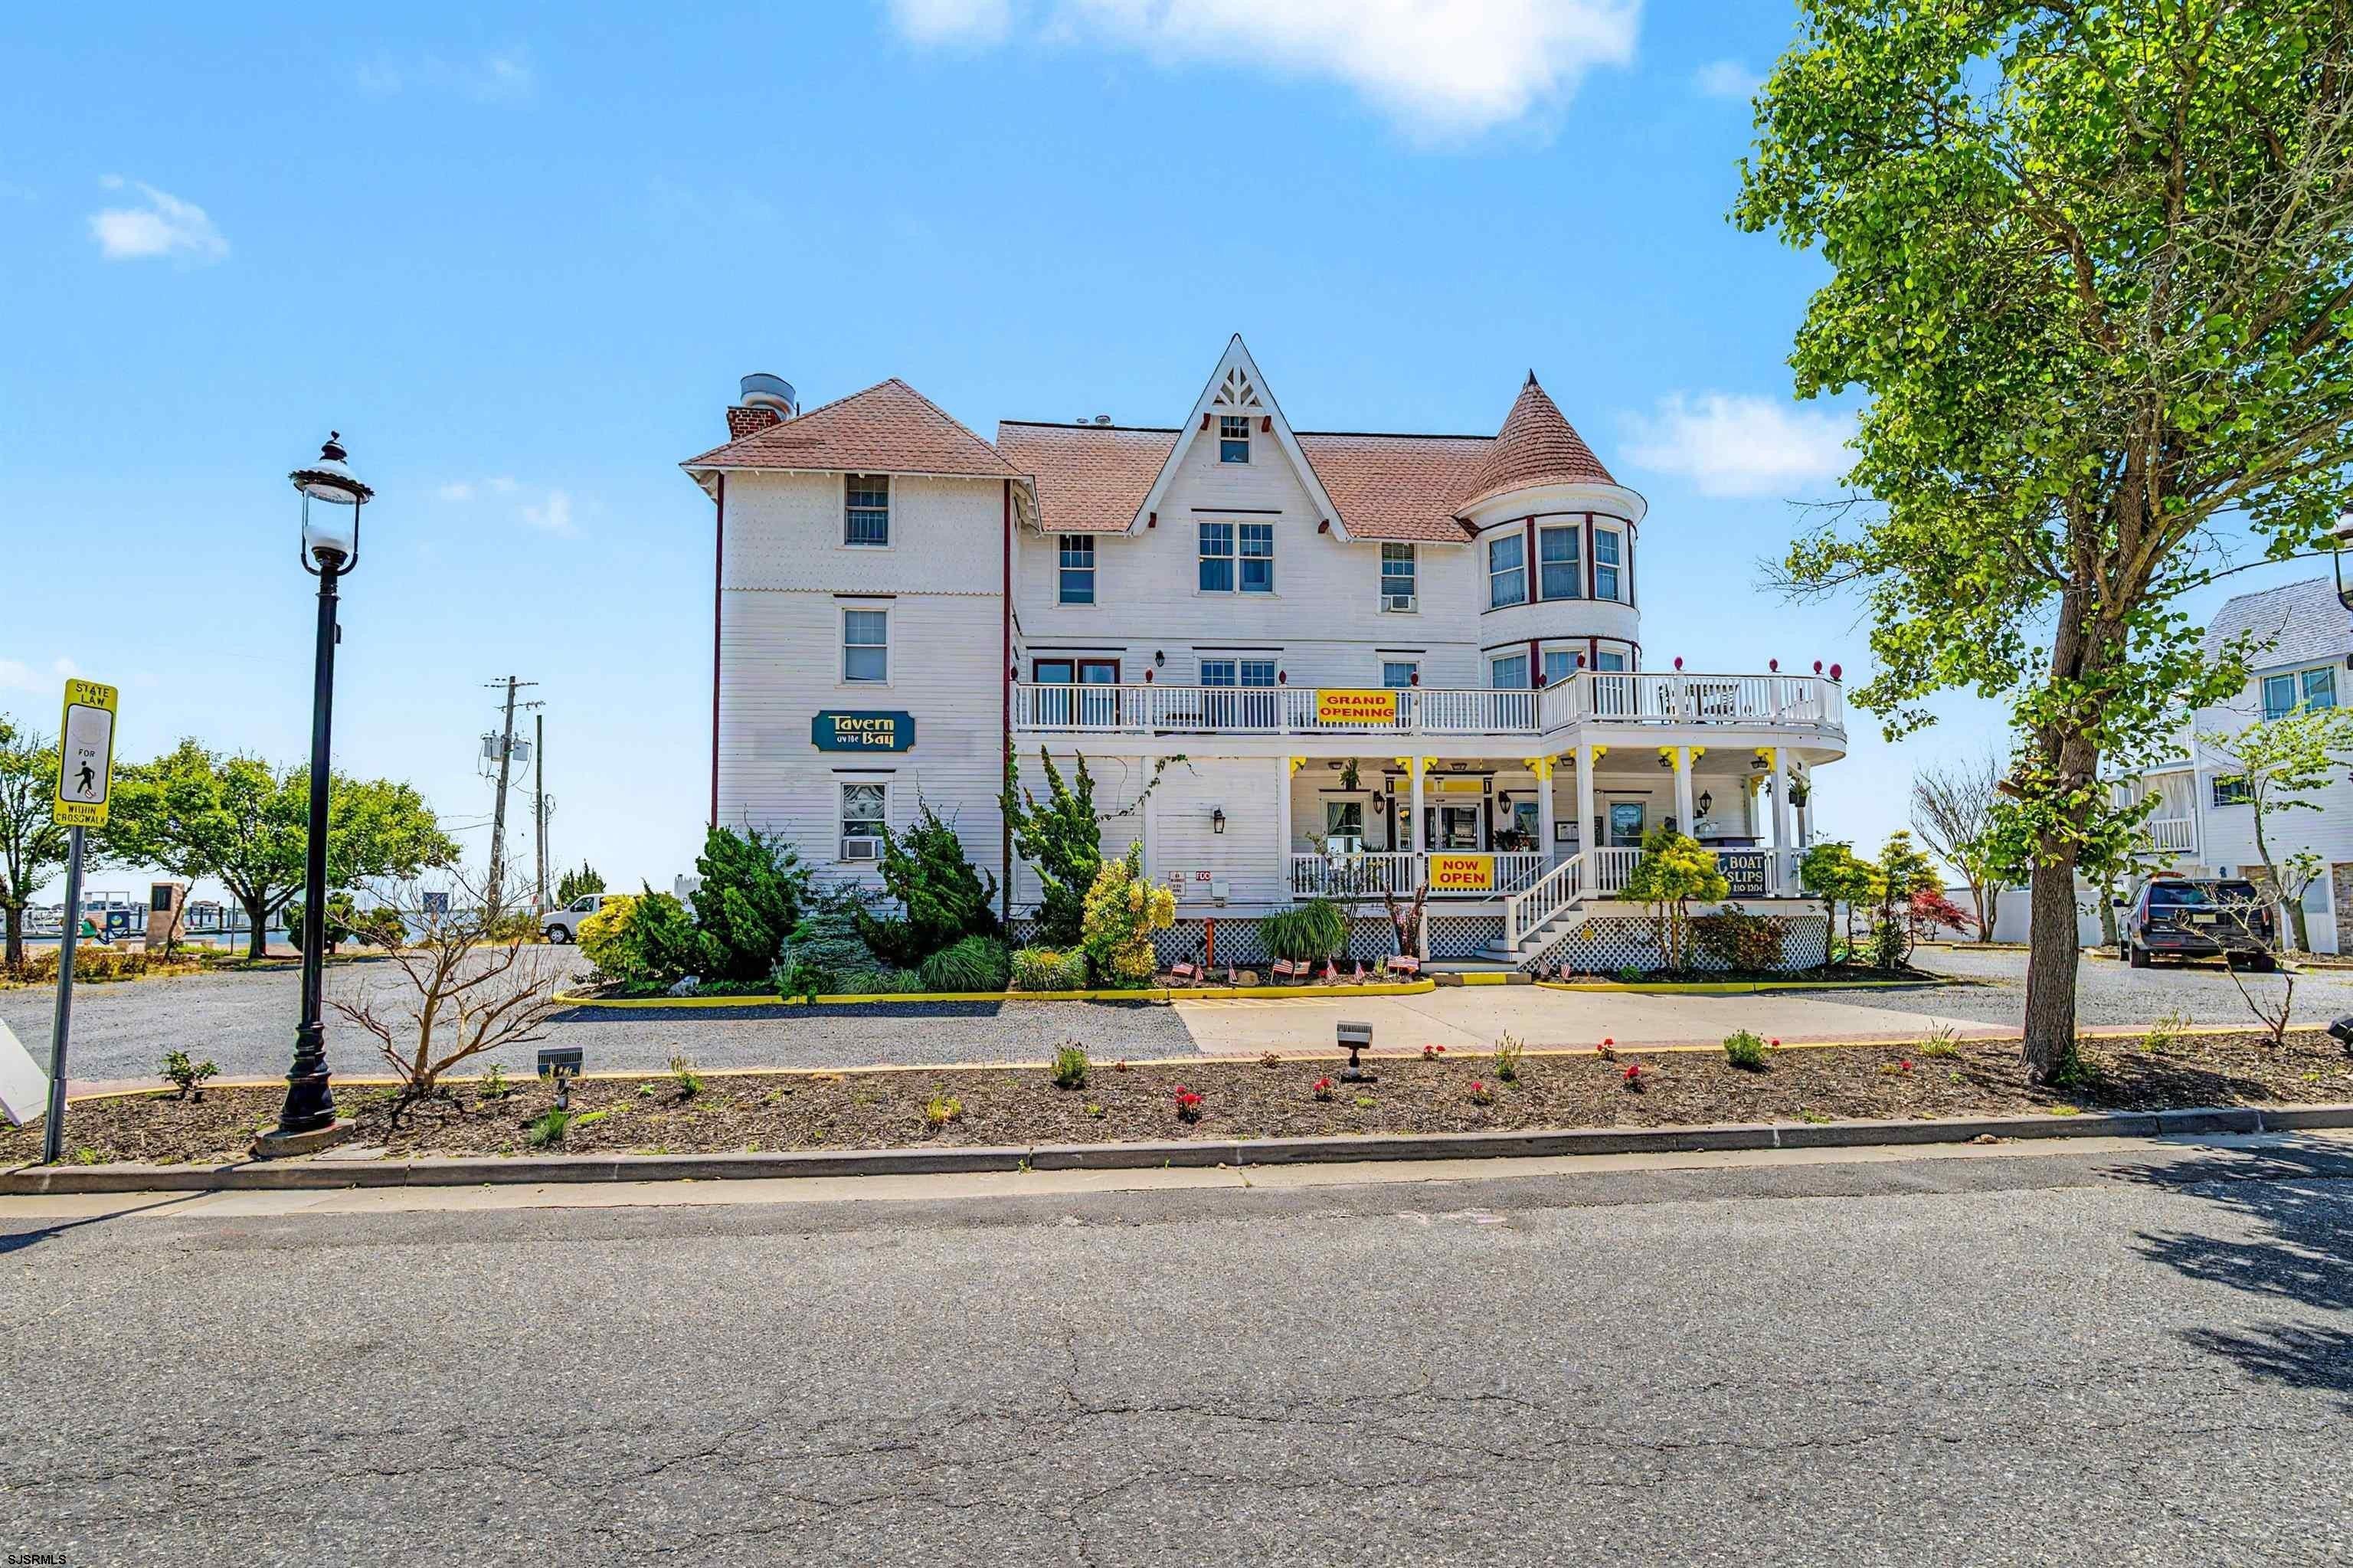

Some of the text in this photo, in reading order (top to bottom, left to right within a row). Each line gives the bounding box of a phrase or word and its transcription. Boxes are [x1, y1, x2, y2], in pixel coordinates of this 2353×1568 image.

[76, 683, 110, 698] STATE
[81, 694, 105, 706] LAW
[1327, 696, 1386, 705] GRAND
[1320, 707, 1394, 717] OPENING
[828, 715, 895, 731] Tavern
[862, 732, 895, 748] Bay
[78, 748, 96, 758] FOR
[68, 805, 97, 815] WITHIN
[56, 813, 105, 824] CROSSWALK
[1443, 860, 1478, 870] NOW
[1730, 856, 1763, 869] BOAT
[1439, 873, 1485, 883] OPEN
[1726, 871, 1764, 882] SLIPS
